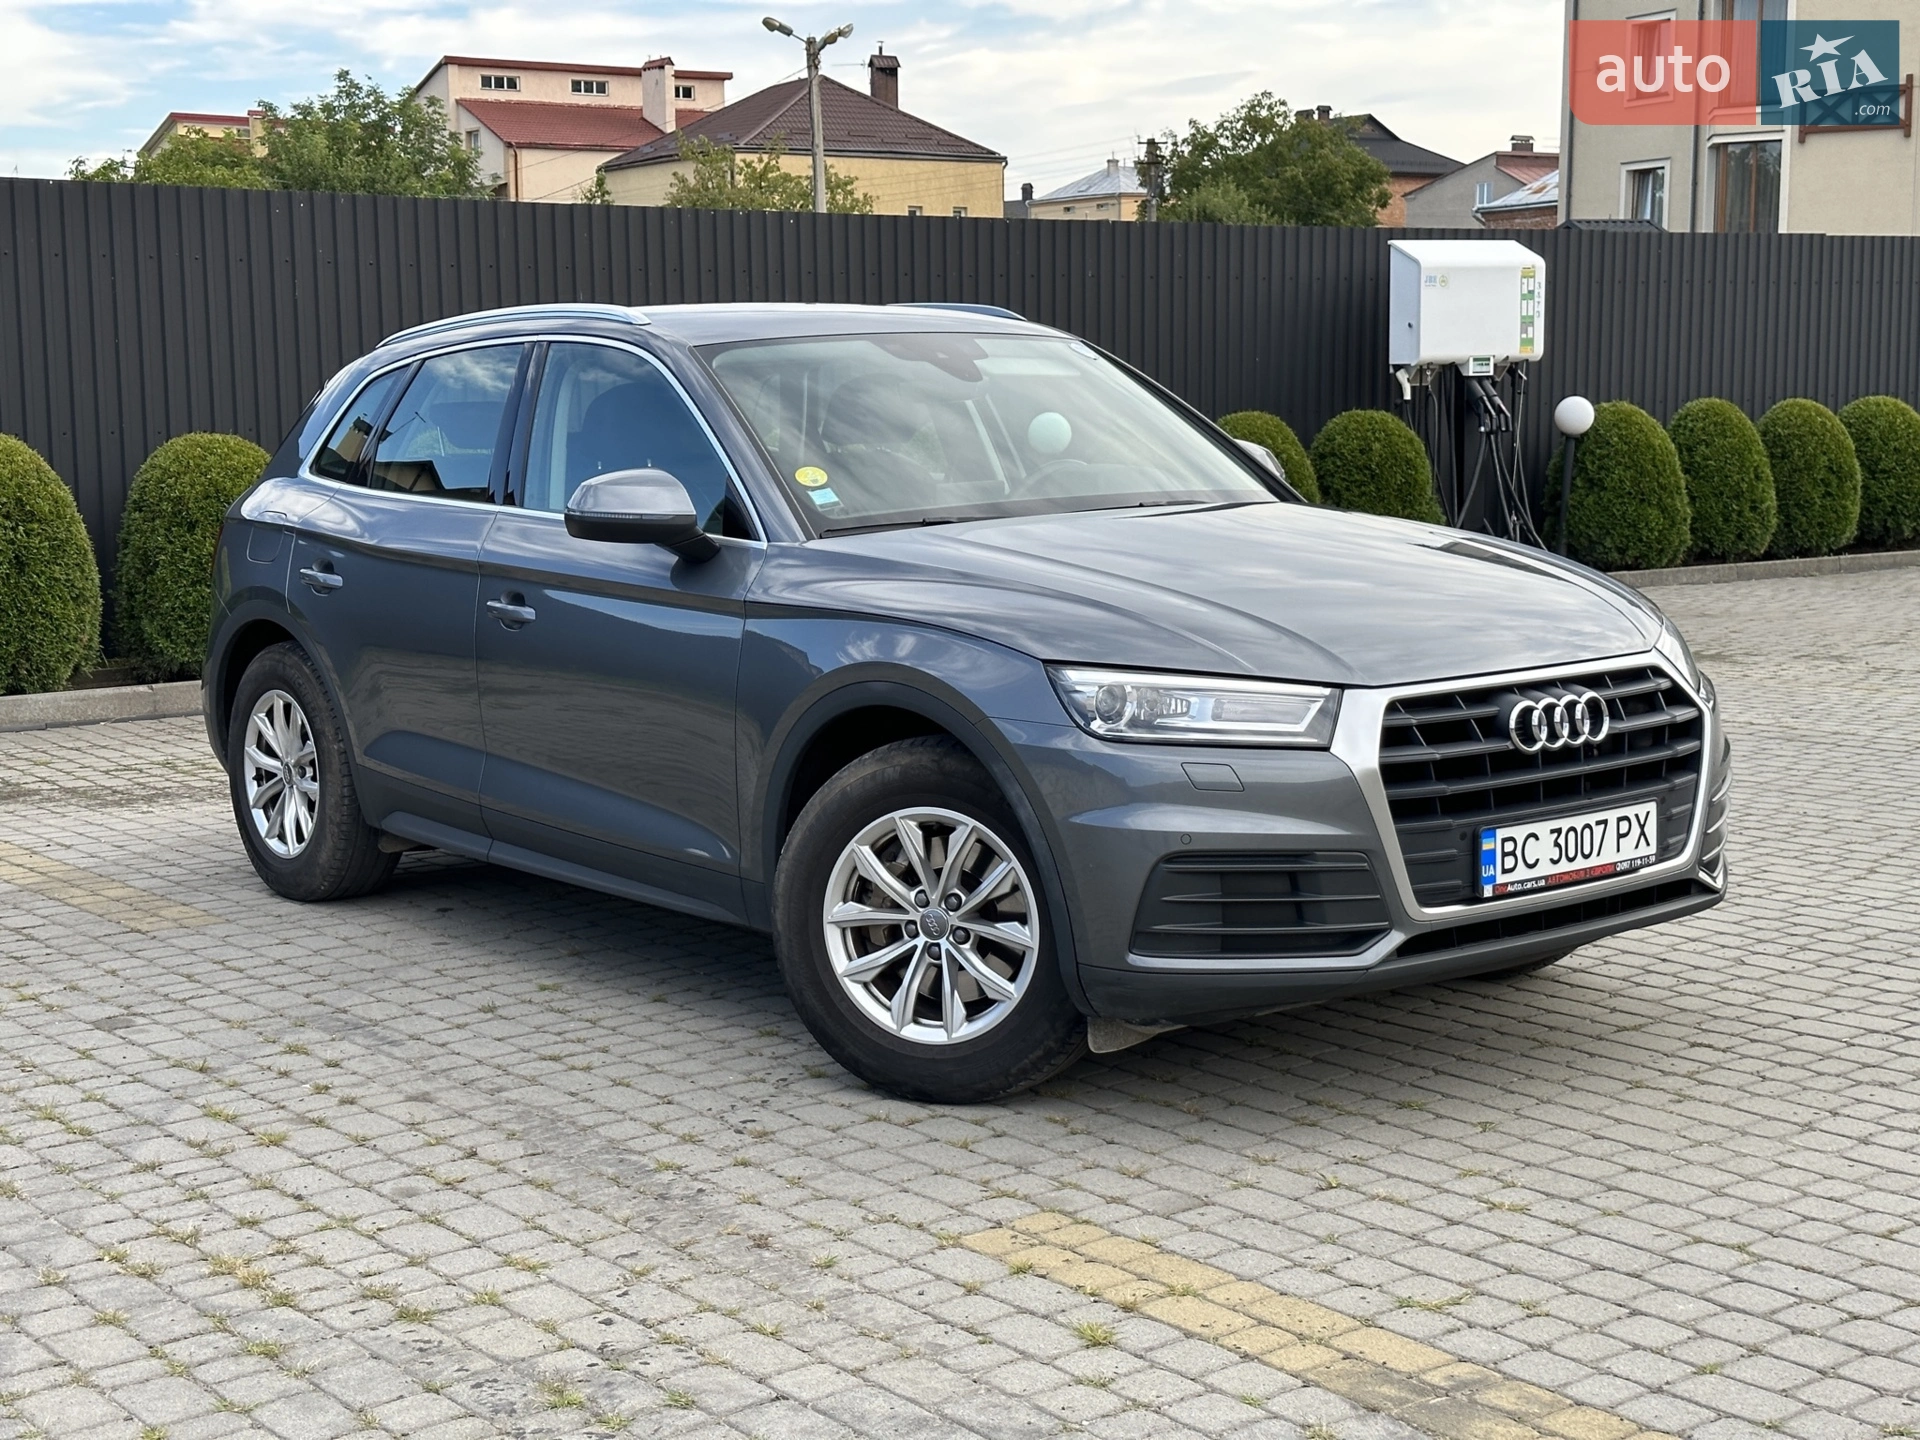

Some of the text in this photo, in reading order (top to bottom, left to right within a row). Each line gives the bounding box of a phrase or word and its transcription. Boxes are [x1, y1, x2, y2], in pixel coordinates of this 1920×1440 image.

[1501, 811, 1651, 875] BC 3007 PX
[1482, 864, 1495, 877] UA
